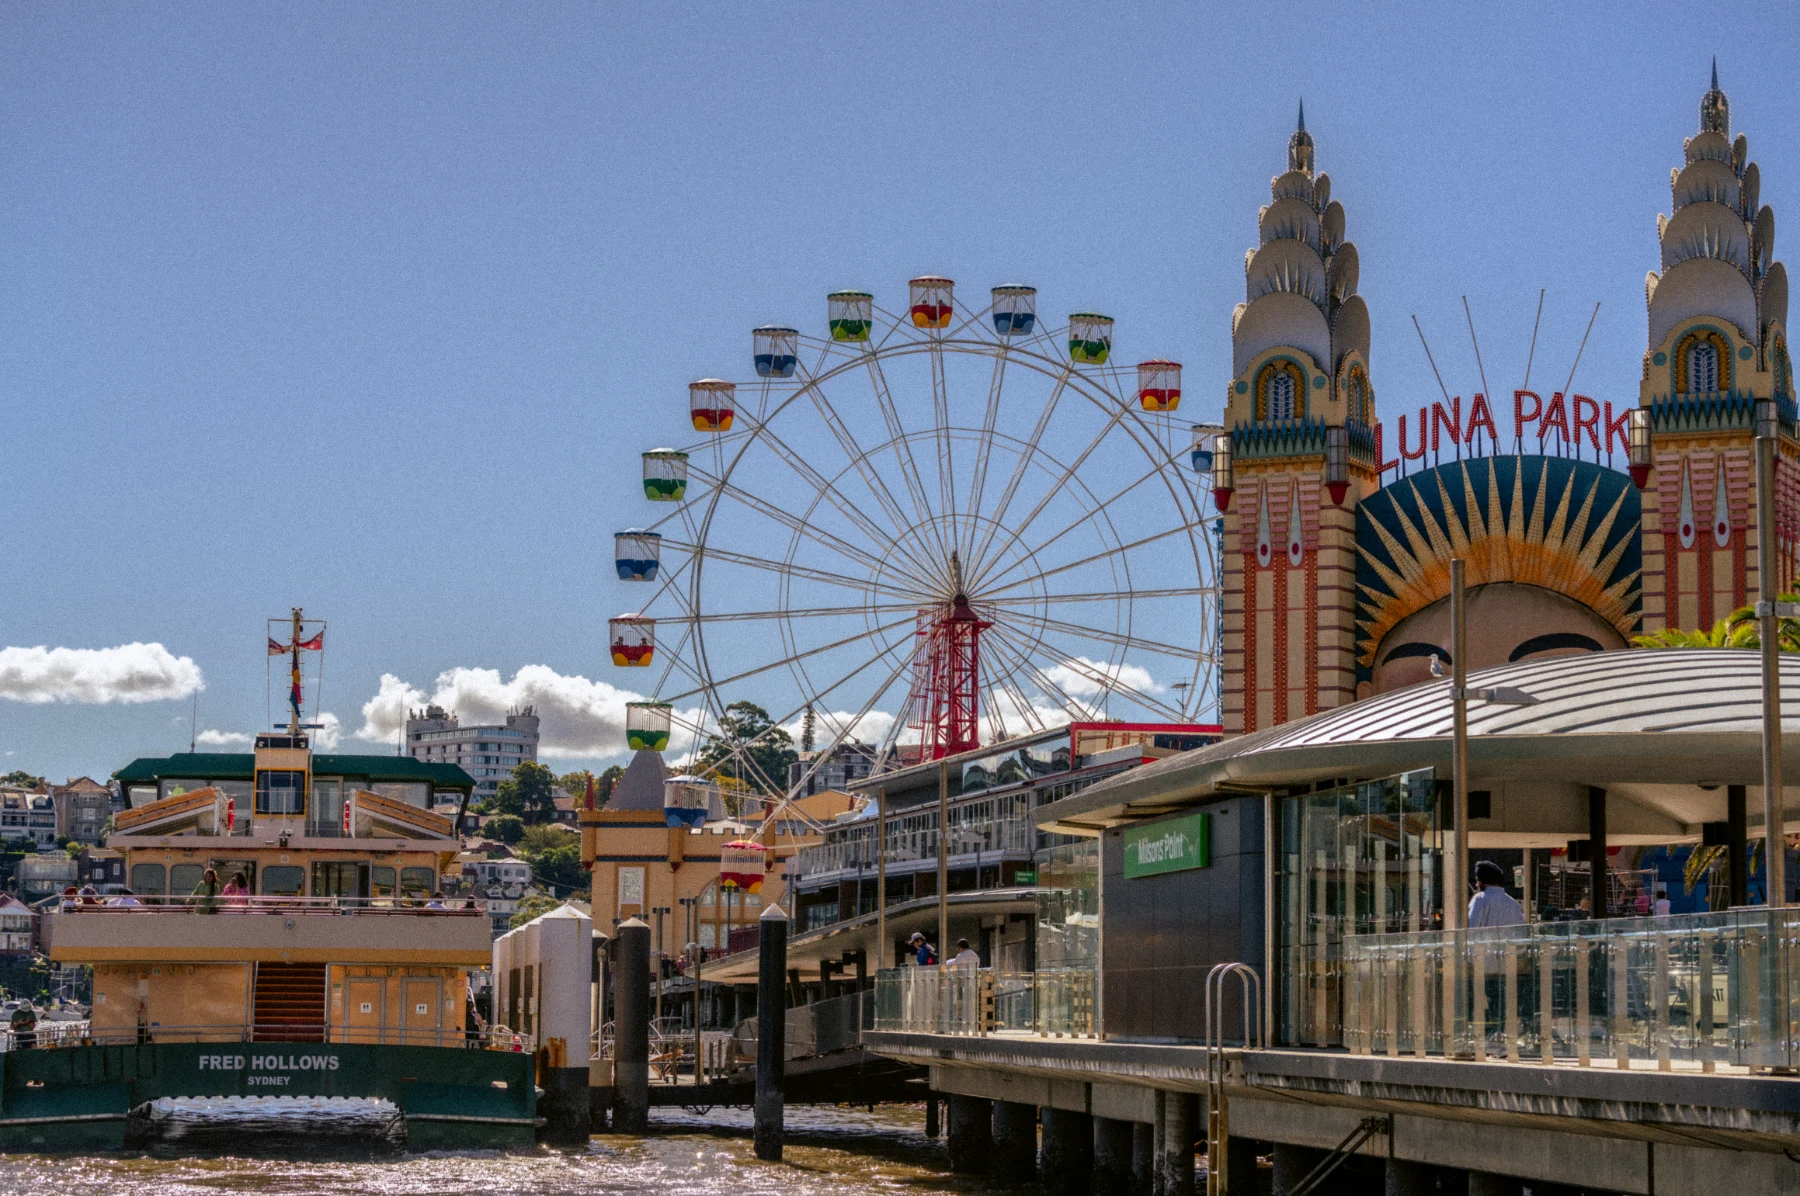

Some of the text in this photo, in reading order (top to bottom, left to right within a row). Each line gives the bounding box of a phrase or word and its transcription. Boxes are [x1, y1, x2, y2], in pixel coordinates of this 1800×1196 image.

[1374, 389, 1632, 475] LUNA PARK
[1138, 830, 1184, 865] Milsons Point
[198, 1054, 340, 1071] FRED HOLLOWS
[247, 1076, 291, 1086] SYDNEY
